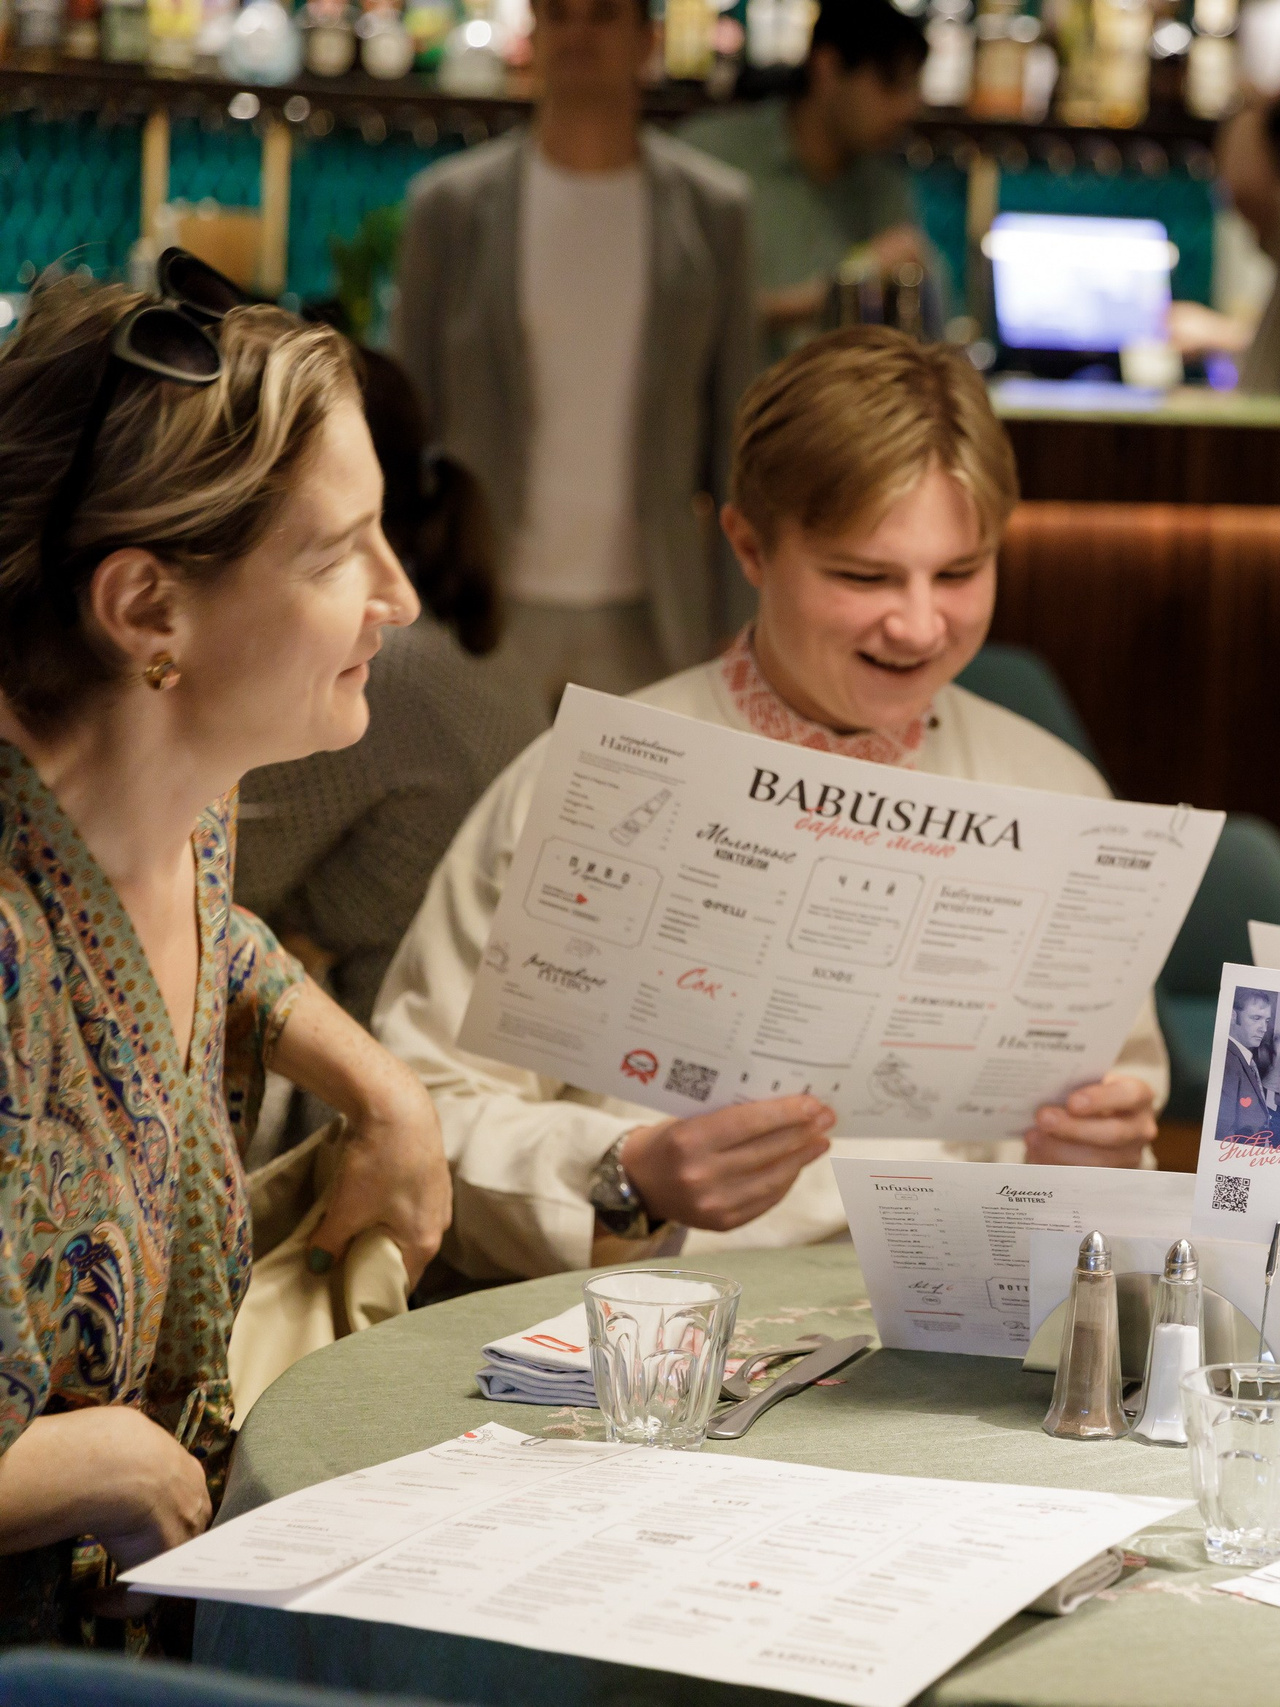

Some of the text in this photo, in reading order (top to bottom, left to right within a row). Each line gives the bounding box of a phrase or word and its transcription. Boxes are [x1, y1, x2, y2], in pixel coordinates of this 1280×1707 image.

[874, 1183, 934, 1193] Infusions
[995, 1185, 1054, 1199] Liqueurs
[1015, 1196, 1046, 1204] BITTERS
